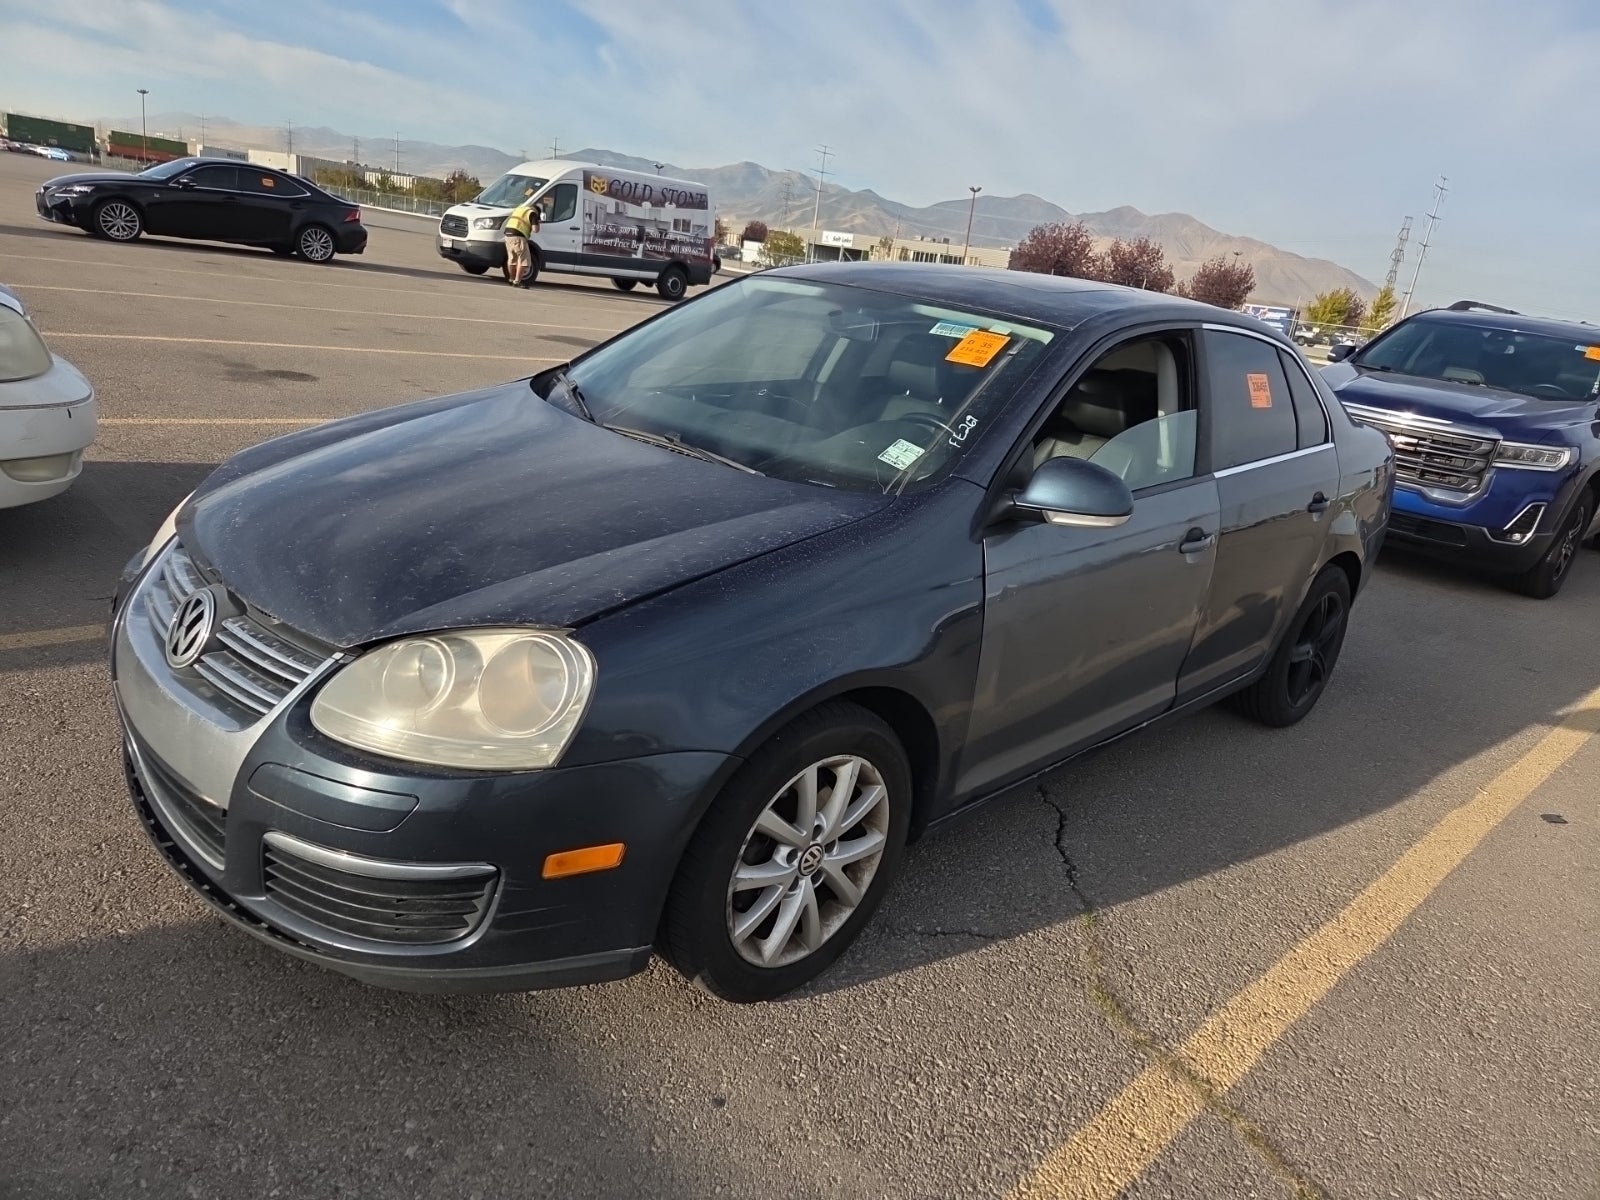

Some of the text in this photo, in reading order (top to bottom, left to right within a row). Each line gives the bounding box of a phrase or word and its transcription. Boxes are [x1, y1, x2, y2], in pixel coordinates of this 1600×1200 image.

[609, 179, 708, 209] GOLD STONE
[590, 235, 614, 246] Lowest
[614, 237, 630, 248] Price
[645, 241, 667, 252] Service
